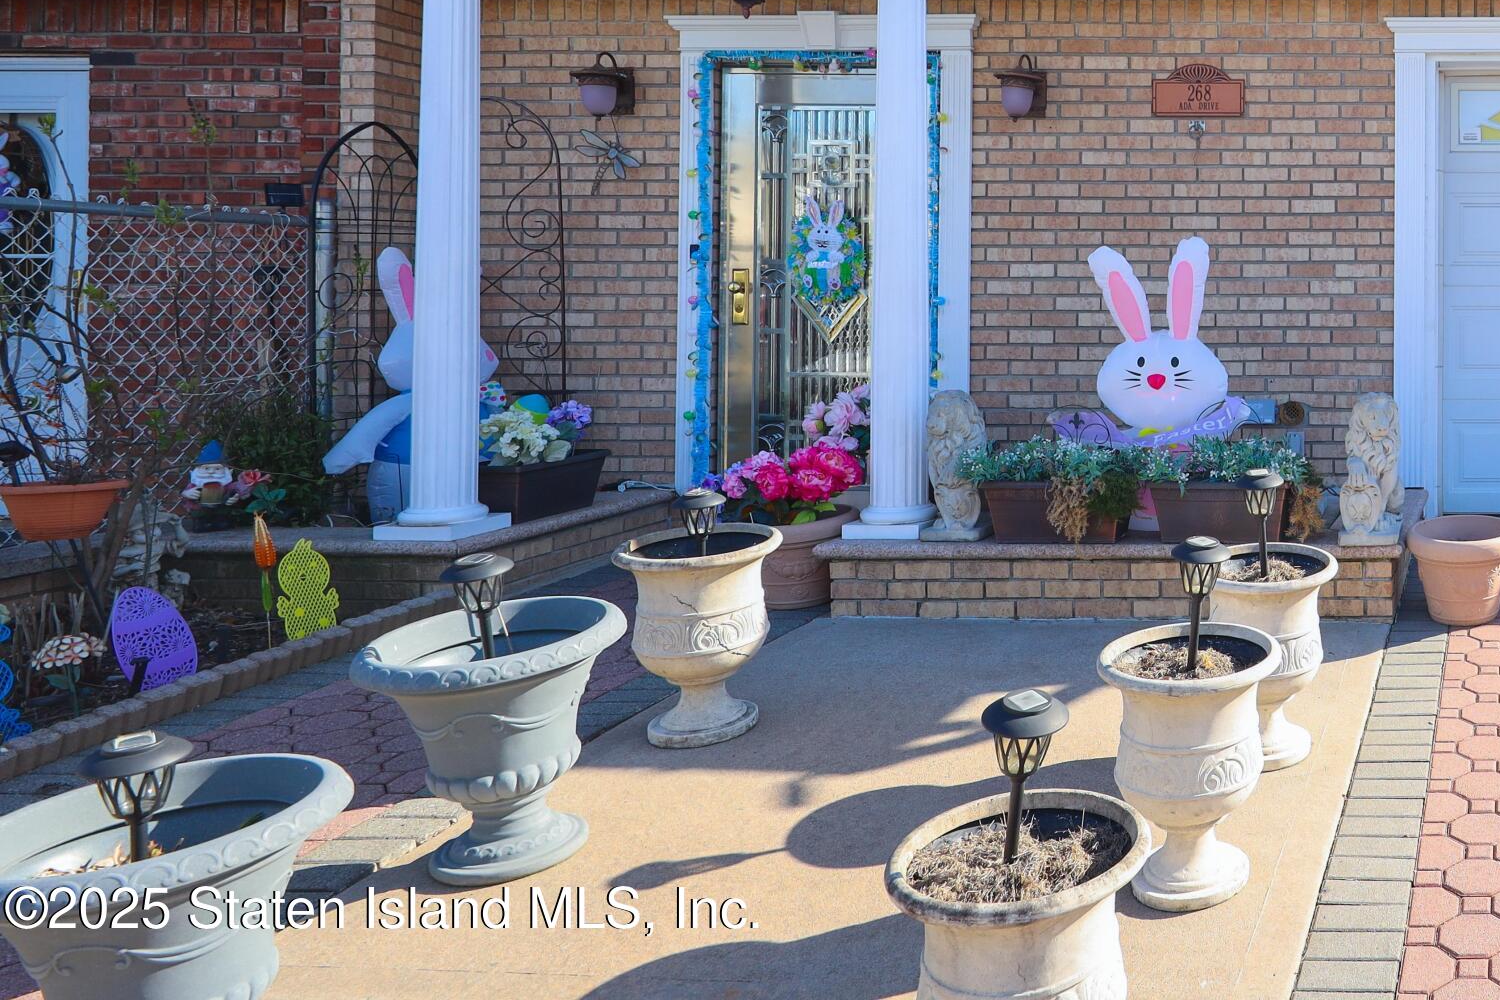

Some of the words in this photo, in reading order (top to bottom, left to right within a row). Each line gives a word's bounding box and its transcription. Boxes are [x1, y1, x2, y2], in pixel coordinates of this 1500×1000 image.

[1187, 84, 1212, 102] 268
[1179, 101, 1193, 111] ADA
[1198, 101, 1220, 111] DRIVE
